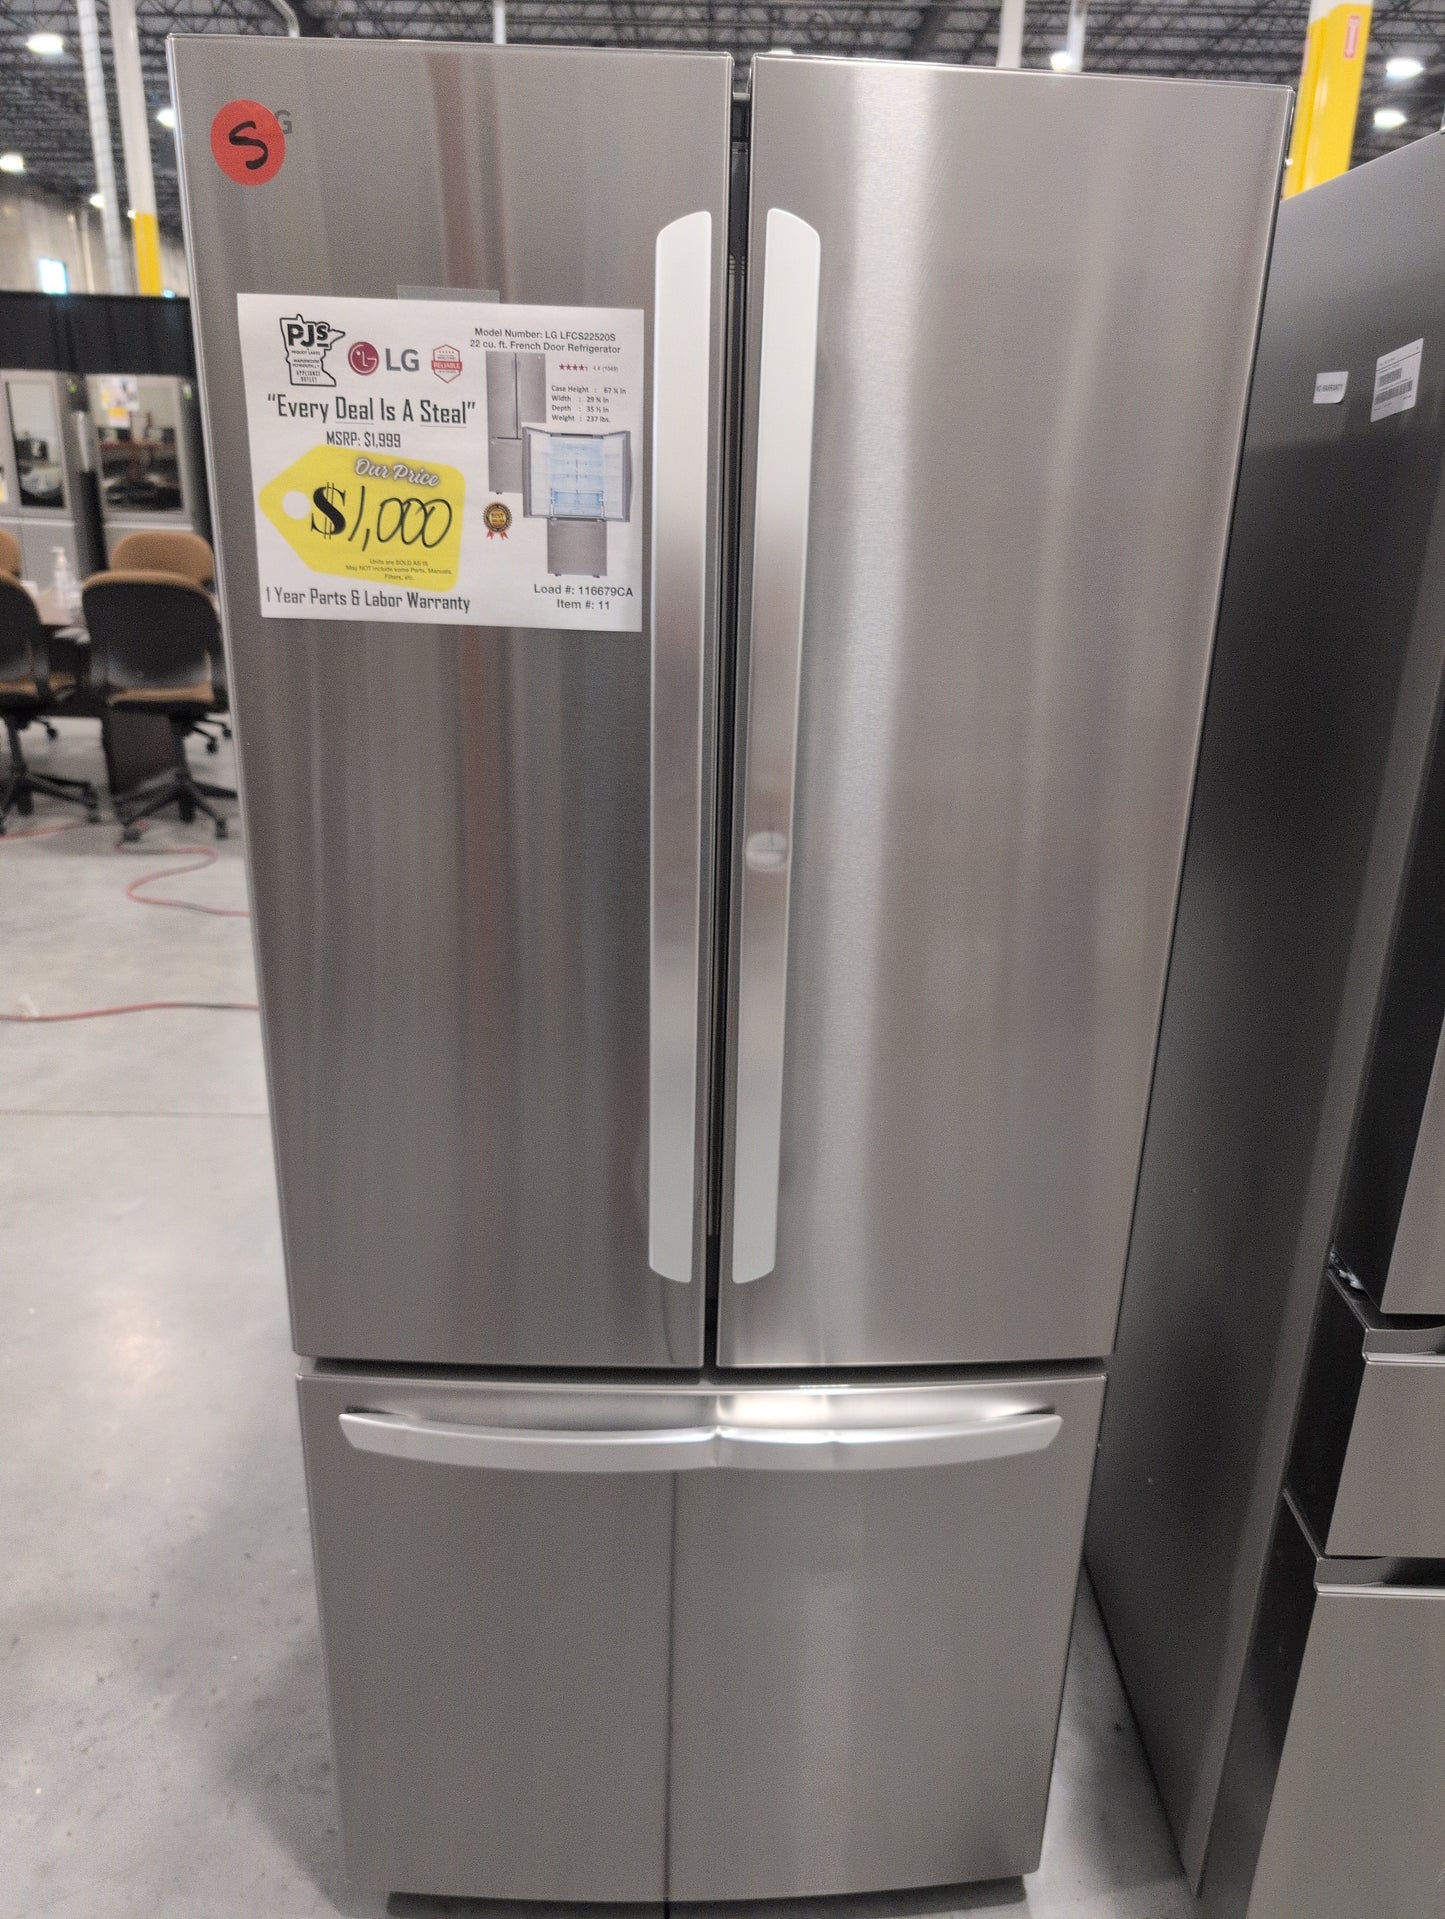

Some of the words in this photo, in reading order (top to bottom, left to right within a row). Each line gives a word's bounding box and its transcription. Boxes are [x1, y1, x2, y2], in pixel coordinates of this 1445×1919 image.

[274, 110, 292, 134] G
[228, 120, 268, 170] S
[287, 324, 328, 347] PJs
[474, 328, 502, 337] Model
[505, 330, 542, 338] Number:
[545, 331, 557, 339] LG
[560, 331, 616, 342] LFCS22520S
[470, 340, 480, 348] 22
[499, 340, 508, 349] ft.
[510, 341, 541, 350] French
[544, 342, 564, 351] Door
[568, 343, 621, 354] Refrigerator
[385, 348, 420, 372] LG
[568, 386, 589, 394] Height
[336, 396, 374, 420] Deal
[381, 398, 396, 421] Is
[403, 399, 414, 422] A
[551, 414, 575, 422] Weight
[326, 431, 360, 446] MSRP:
[364, 432, 401, 448] $1,999
[355, 458, 390, 479] Our
[393, 464, 440, 487] Price
[266, 587, 270, 602] 1
[274, 586, 305, 604] Year
[310, 588, 347, 605] Parts
[351, 590, 360, 606] &
[365, 590, 402, 608] Labor
[407, 592, 470, 614] Warranty
[534, 584, 562, 594] Load
[565, 585, 575, 595] #:
[579, 586, 634, 597] 116679CA
[557, 599, 581, 609] Item
[585, 600, 594, 609] #:
[599, 601, 610, 610] 11
